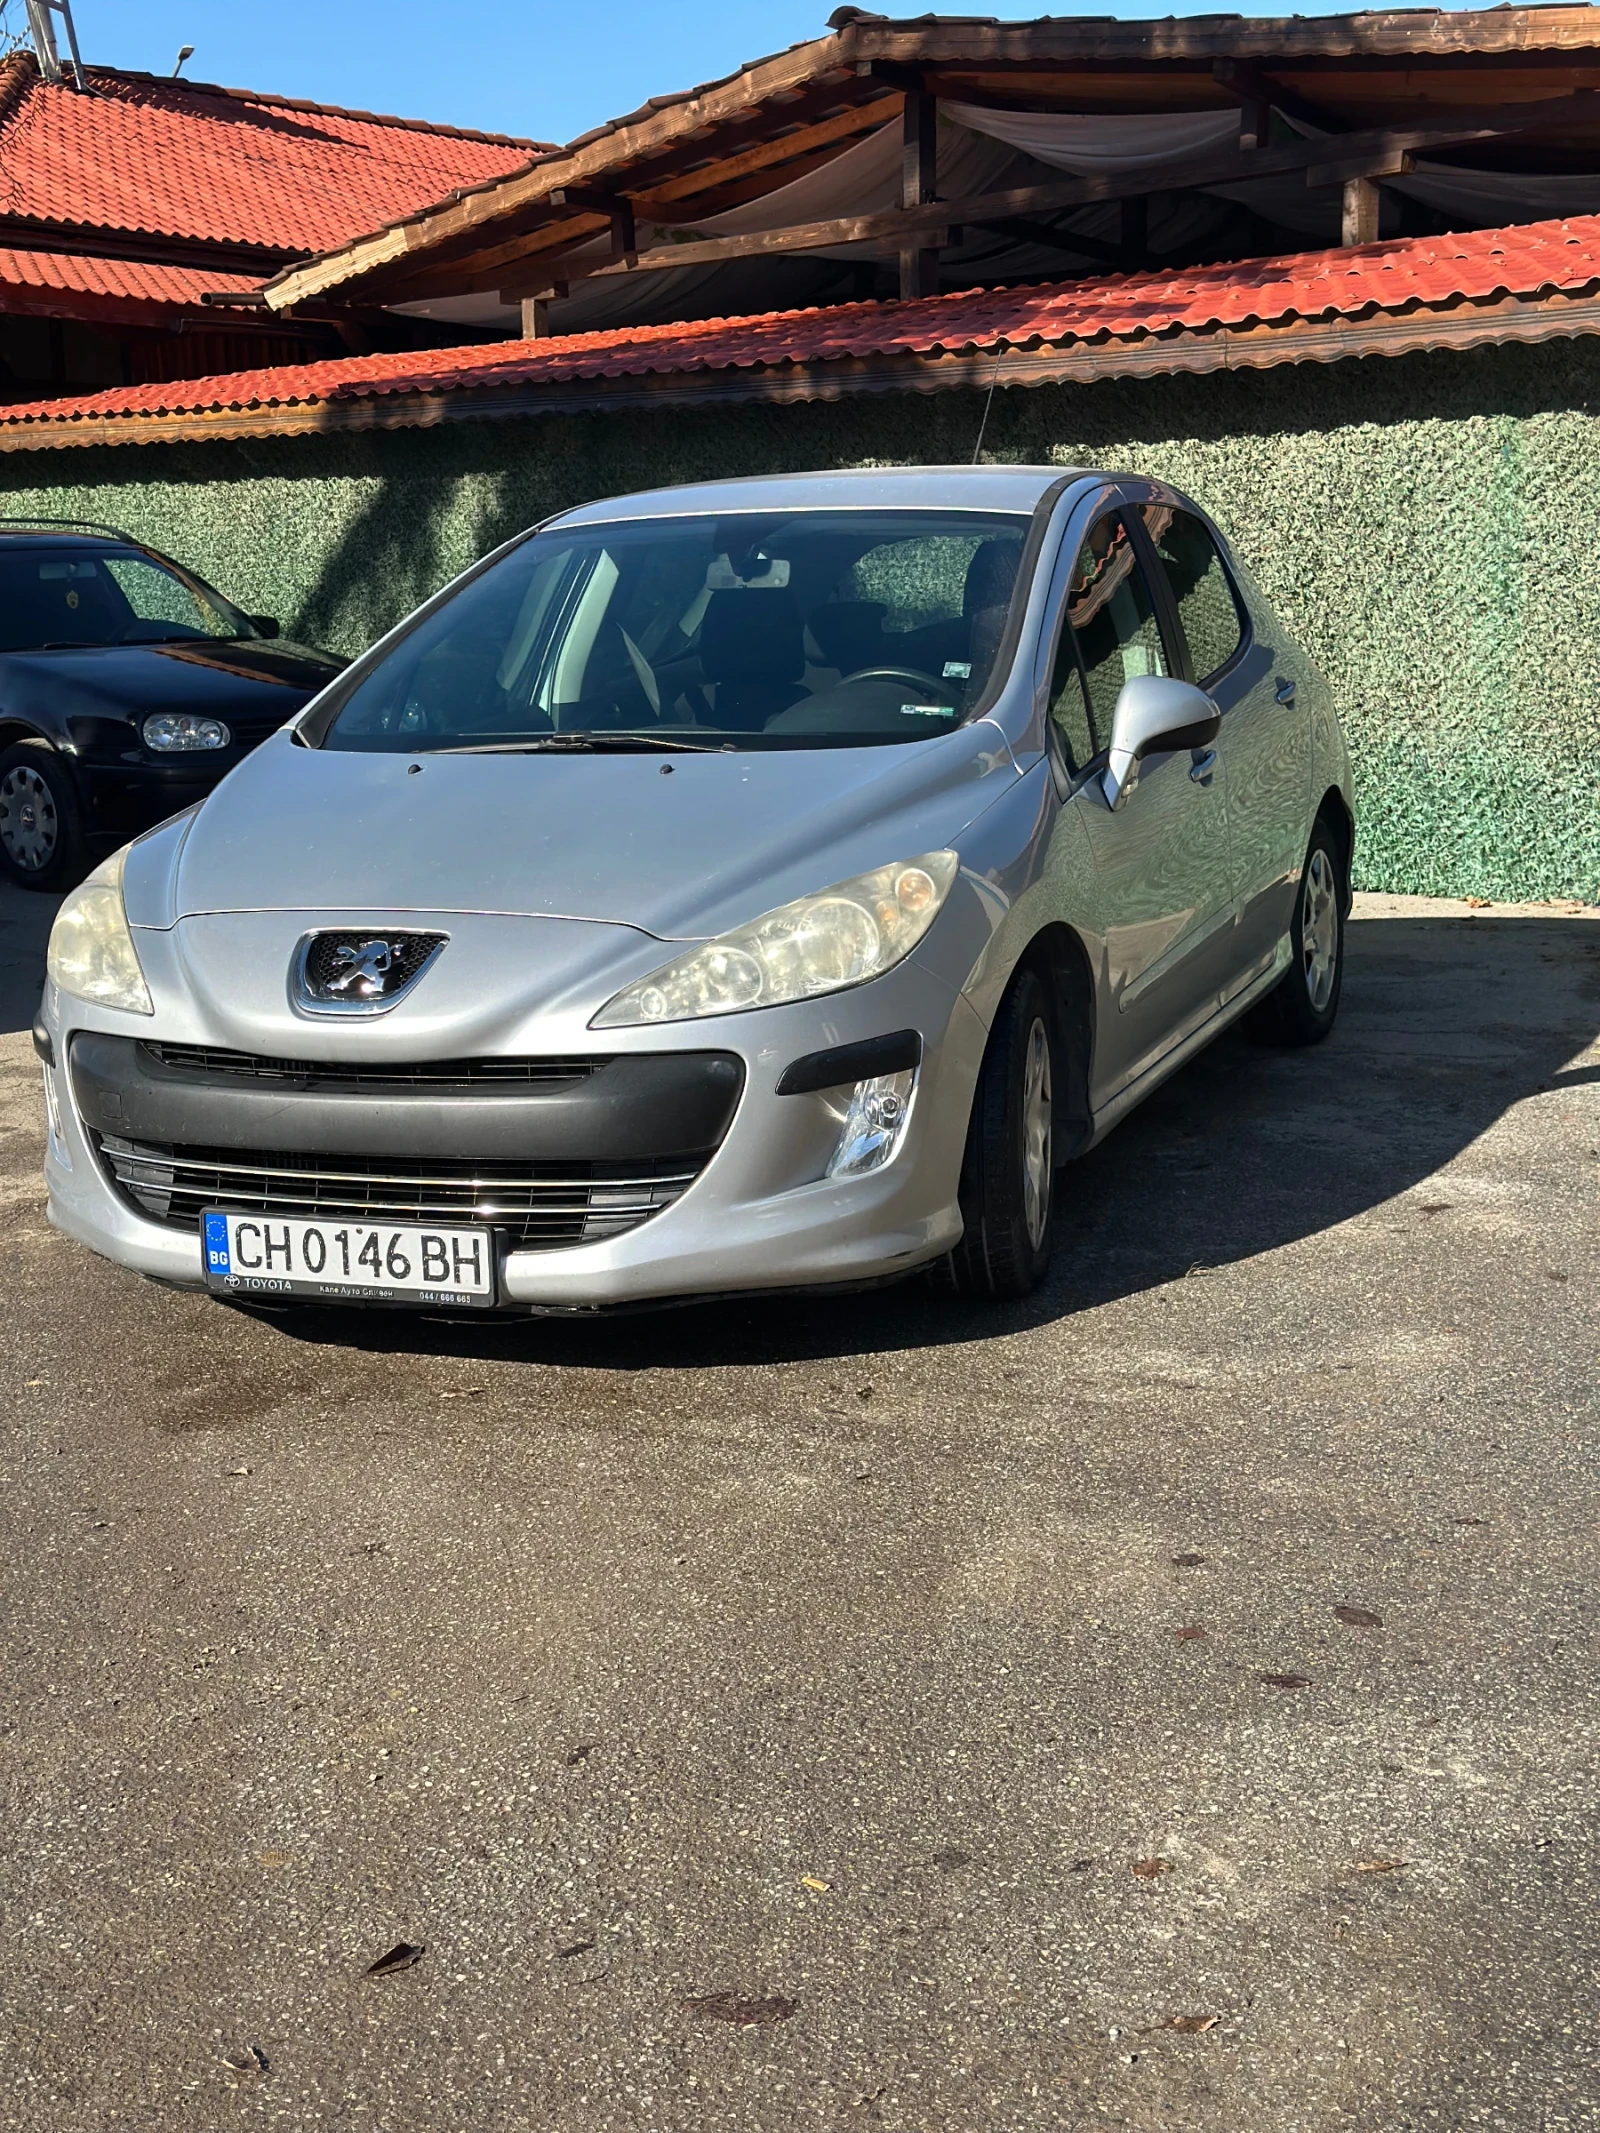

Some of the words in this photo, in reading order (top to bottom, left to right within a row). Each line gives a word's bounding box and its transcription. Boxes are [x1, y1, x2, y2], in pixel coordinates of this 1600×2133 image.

[209, 1251, 229, 1266] BG
[235, 1222, 293, 1272] CH
[302, 1227, 412, 1280] 0146
[420, 1234, 482, 1286] BH
[244, 1277, 293, 1291] TOYOTA
